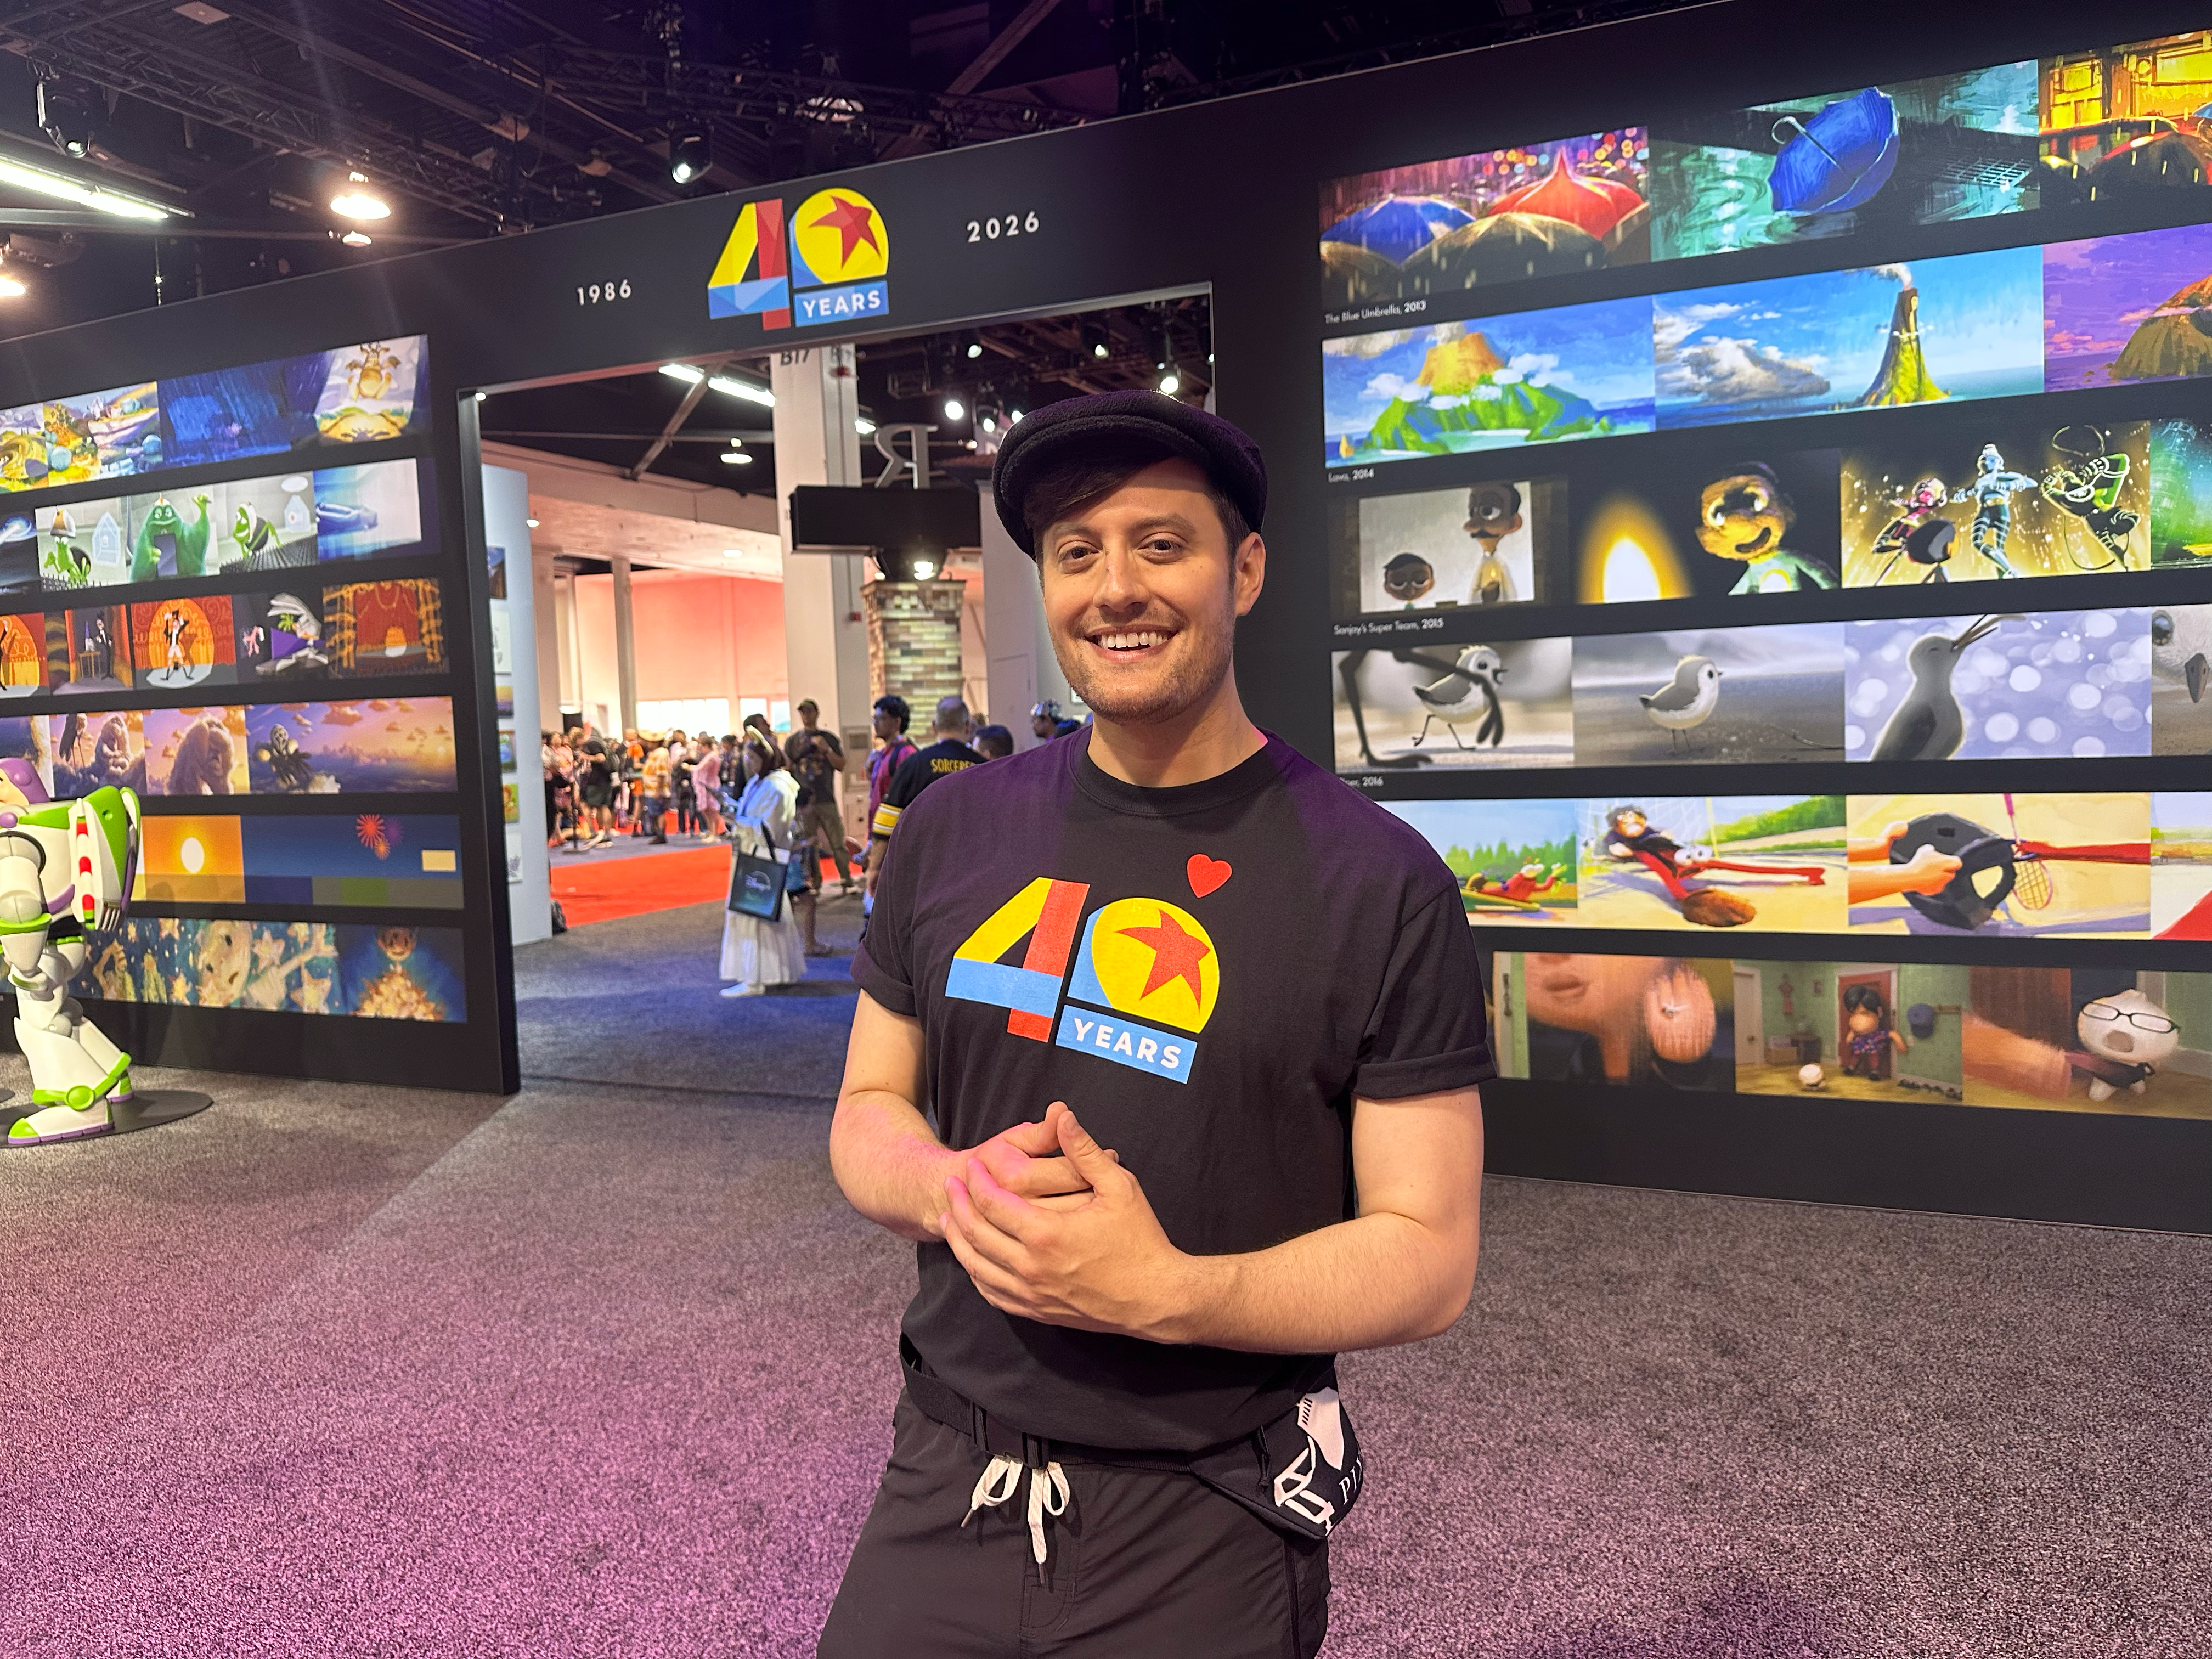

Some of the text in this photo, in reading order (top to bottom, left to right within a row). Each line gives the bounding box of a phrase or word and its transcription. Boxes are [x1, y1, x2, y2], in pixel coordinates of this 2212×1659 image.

[967, 211, 1039, 243] 2026
[577, 279, 631, 306] 1986
[803, 290, 881, 318] YEARS
[1324, 299, 1427, 324] The Blue Umbrella, 2013
[1352, 467, 1374, 481] 2014
[1368, 622, 1393, 634] Super
[1395, 620, 1420, 631] Team,
[1421, 617, 1444, 629] 2015
[1362, 776, 1385, 787] 2016
[1074, 1017, 1182, 1069] YEARS
